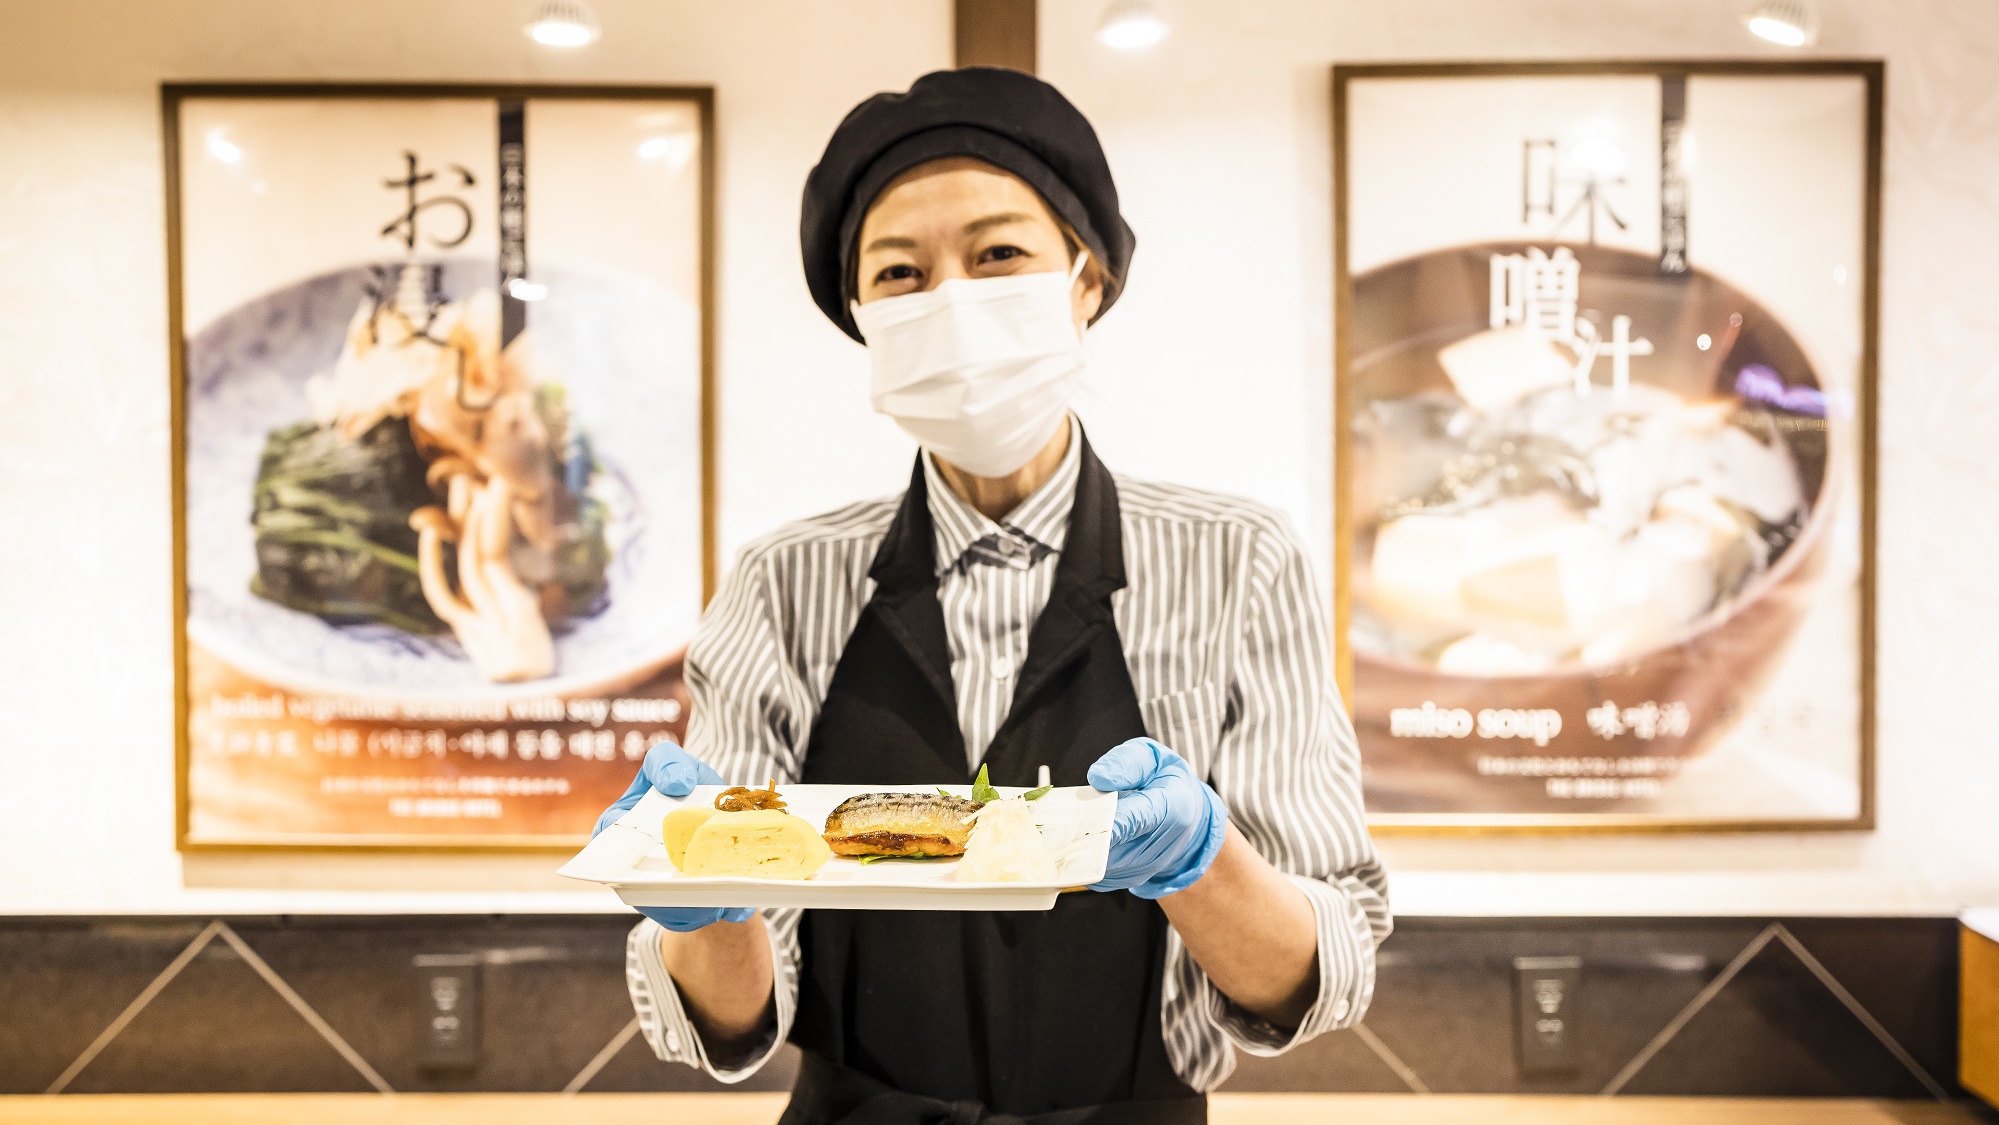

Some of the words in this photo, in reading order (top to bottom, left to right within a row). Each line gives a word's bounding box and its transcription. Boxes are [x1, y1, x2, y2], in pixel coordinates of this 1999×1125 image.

[566, 697, 611, 727] soy
[611, 698, 682, 723] sauce
[1390, 700, 1474, 738] miso
[1476, 708, 1563, 746] soup
